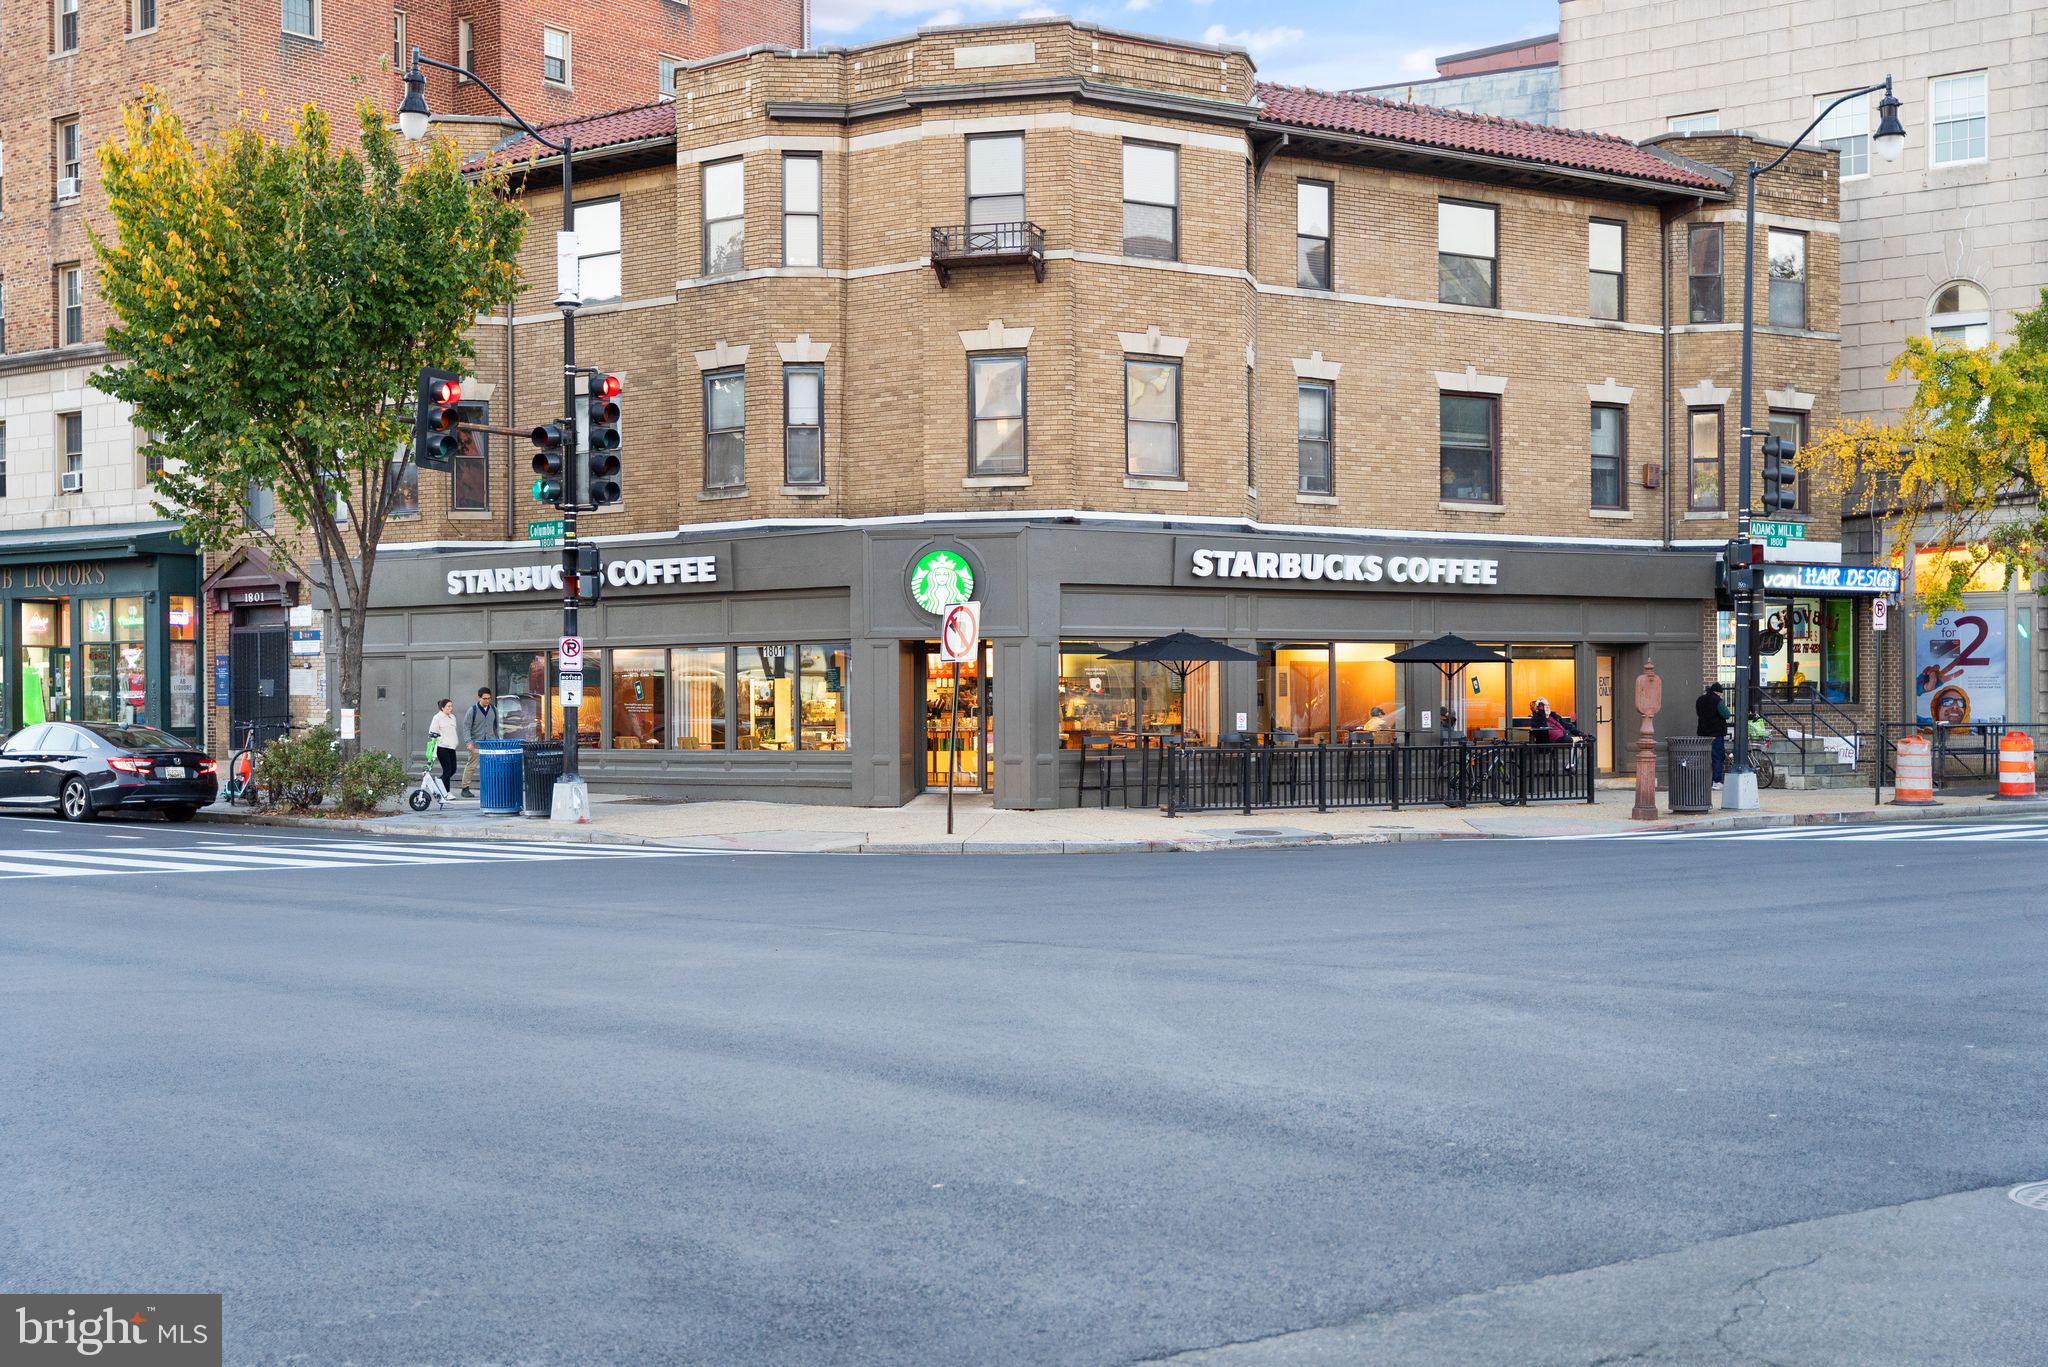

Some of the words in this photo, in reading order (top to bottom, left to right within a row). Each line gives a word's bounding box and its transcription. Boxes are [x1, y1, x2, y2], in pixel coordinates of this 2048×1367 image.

[530, 524, 555, 536] Columbia
[1752, 523, 1775, 535] ADAMS
[1778, 525, 1793, 536] MILL
[1771, 538, 1783, 546] 1800
[1191, 549, 1382, 582] STARBUCKS
[1387, 557, 1498, 585] COFFEE
[24, 562, 105, 592] LIQUORS
[447, 564, 605, 596] STARBUC
[607, 556, 717, 588] COFFEE
[1763, 567, 1803, 587] vani
[1805, 567, 1840, 586] HAIR
[1846, 568, 1897, 588] DESIGN
[244, 592, 265, 603] 1801
[1933, 615, 1950, 626] Go
[1941, 627, 1957, 638] for
[1954, 615, 1990, 666] 2
[763, 646, 784, 657] 1801
